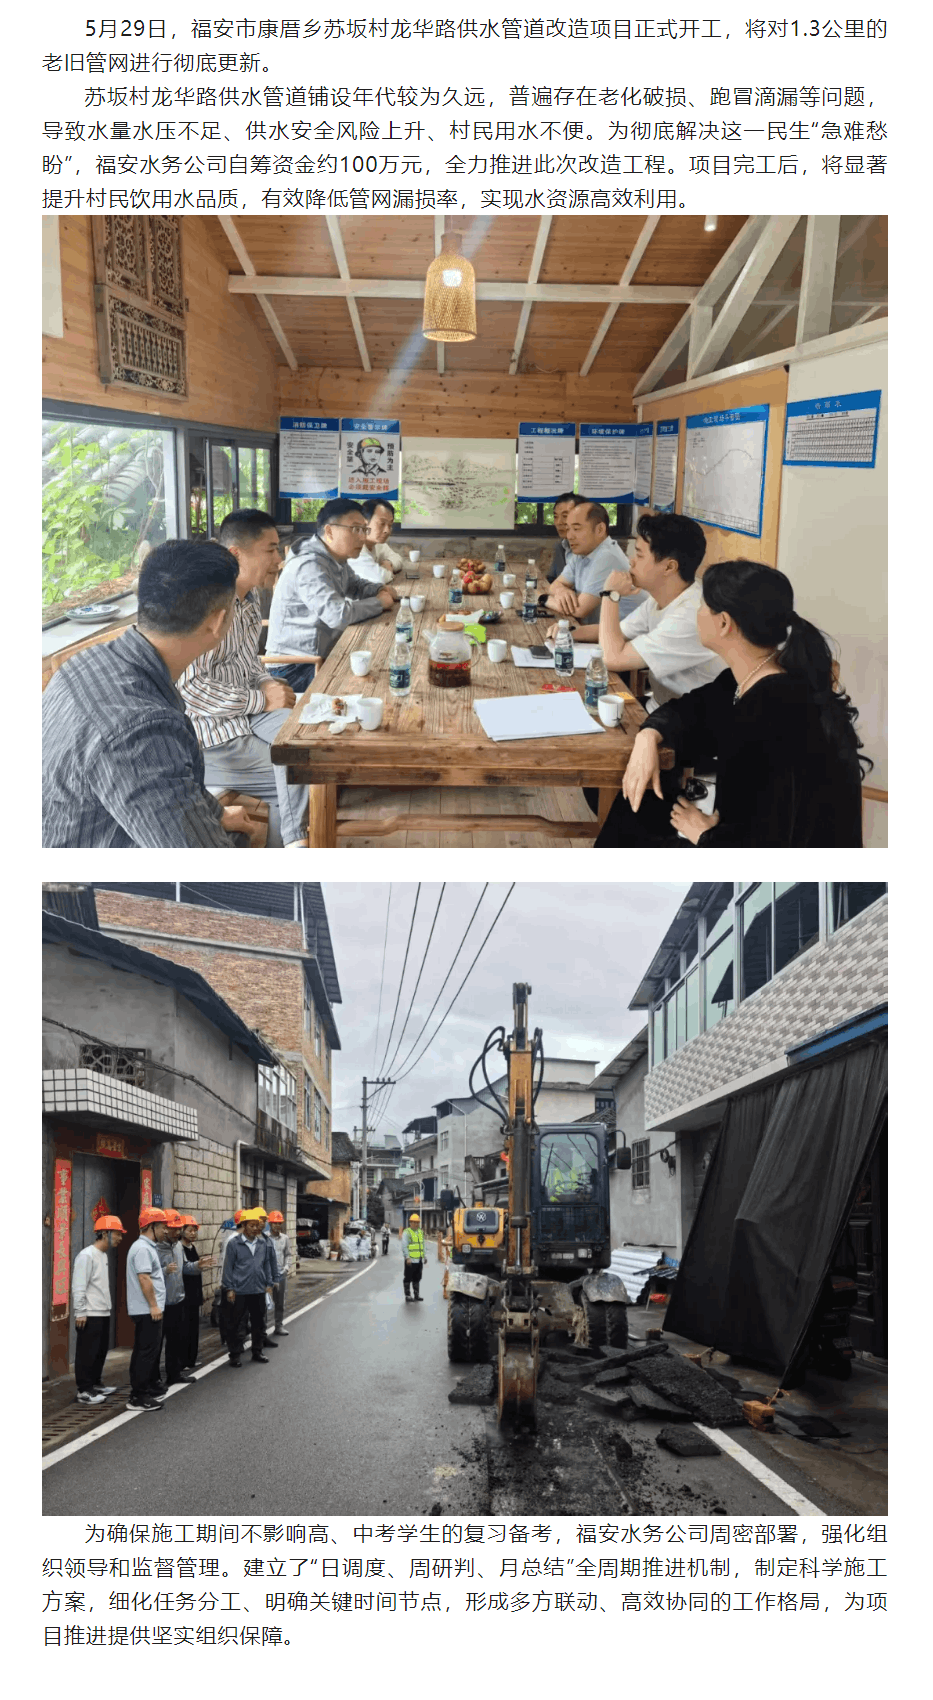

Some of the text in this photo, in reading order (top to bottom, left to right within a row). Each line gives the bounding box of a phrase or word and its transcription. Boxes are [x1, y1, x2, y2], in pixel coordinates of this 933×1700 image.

[346, 441, 354, 468] 安全第一
[386, 443, 394, 471] 预防为主
